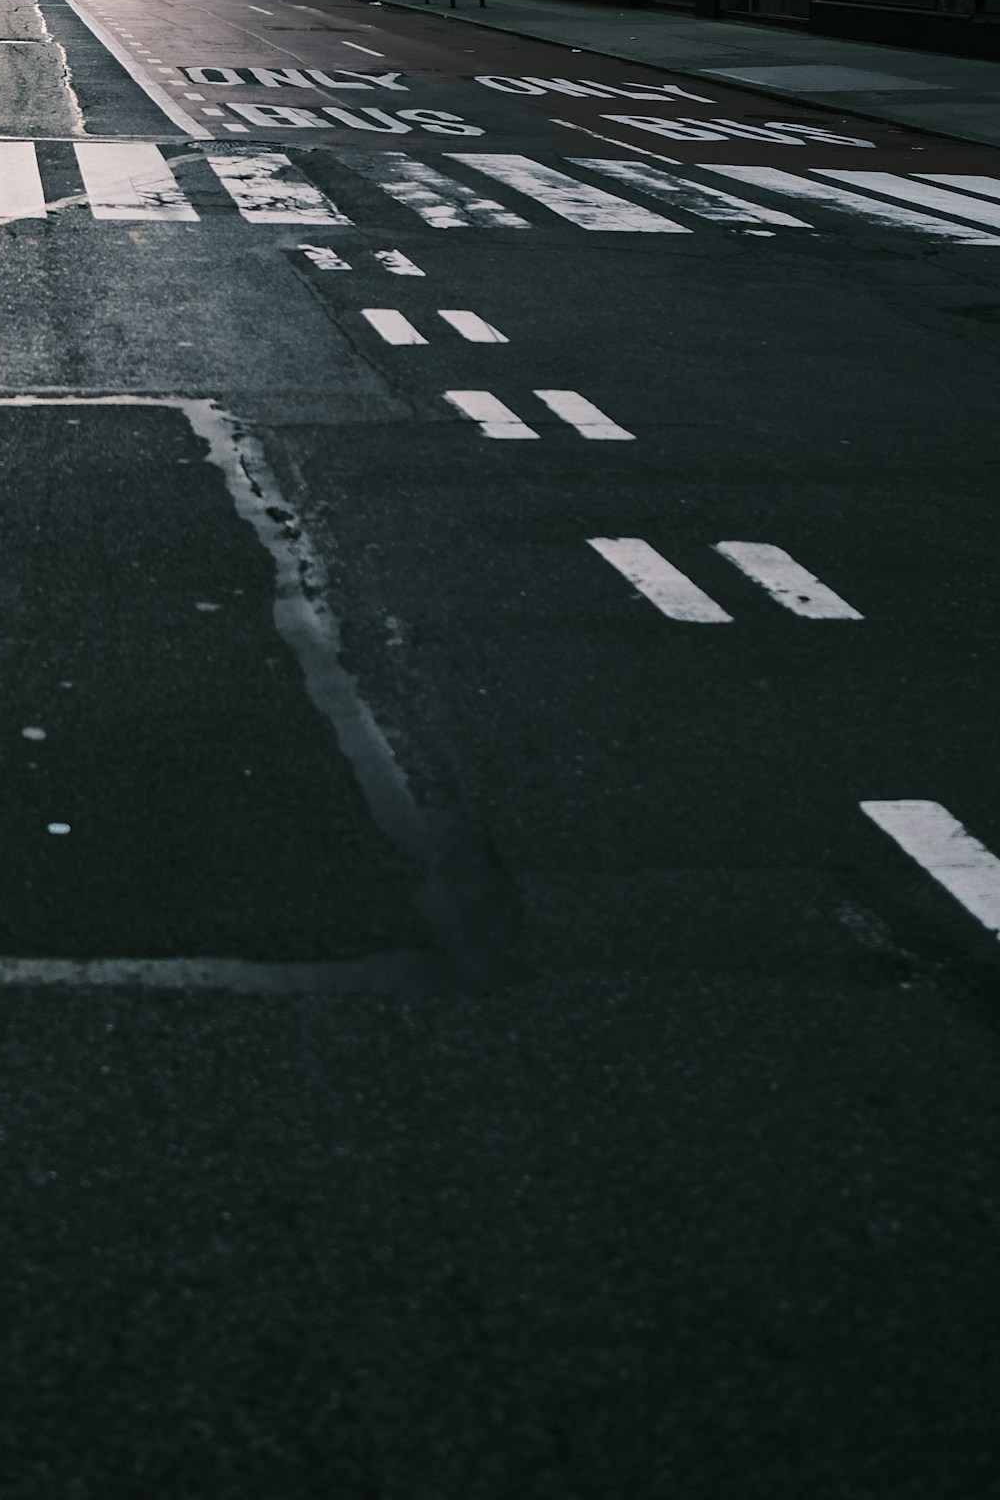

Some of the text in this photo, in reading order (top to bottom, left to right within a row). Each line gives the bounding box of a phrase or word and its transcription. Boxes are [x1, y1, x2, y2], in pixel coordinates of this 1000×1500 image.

[184, 66, 411, 92] ONLY
[473, 75, 718, 104] ONLY
[224, 102, 486, 137] BUS
[598, 114, 878, 149] BUS
